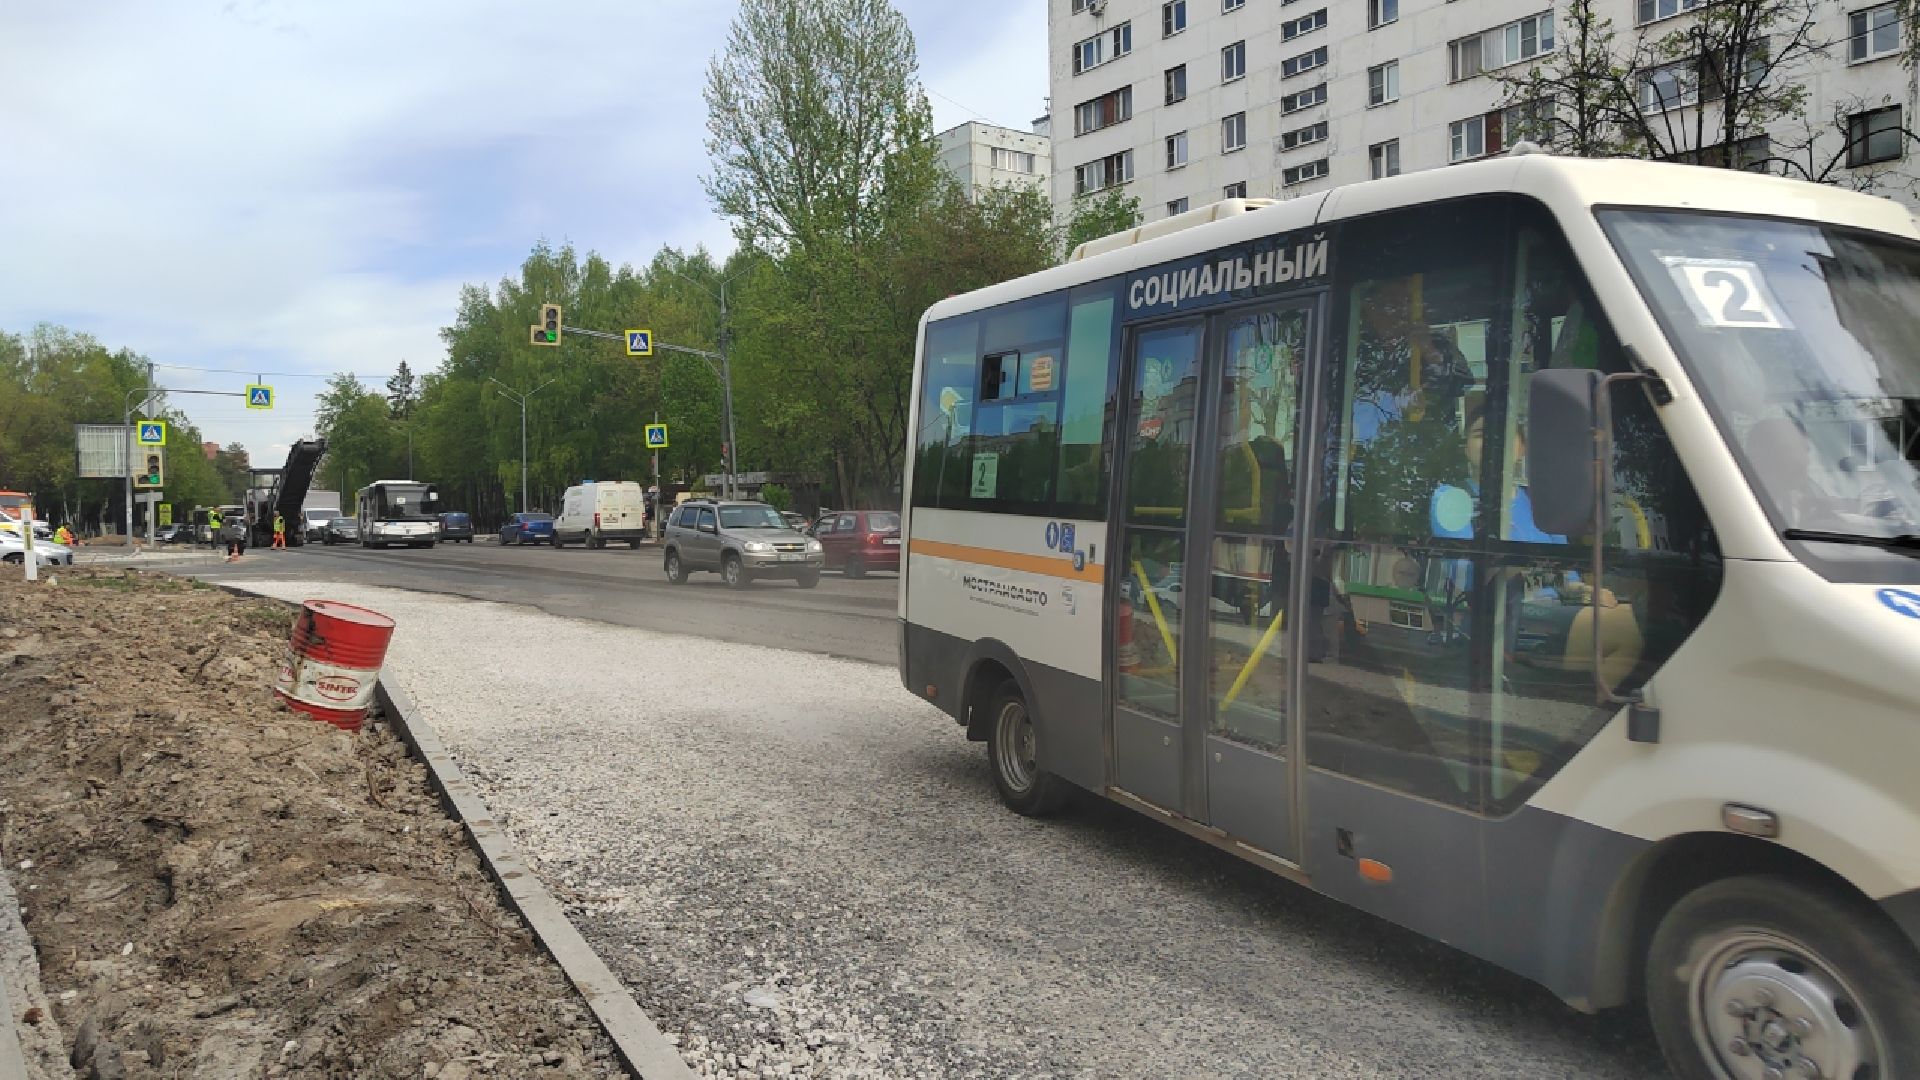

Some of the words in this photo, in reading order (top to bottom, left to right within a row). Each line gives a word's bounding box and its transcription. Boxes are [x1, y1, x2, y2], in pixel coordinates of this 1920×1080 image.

[1129, 232, 1329, 309] СОЦИАЛЬНЫЙ
[1703, 270, 1769, 323] 2
[978, 462, 986, 487] 2
[963, 576, 1047, 606] МОСТРАНСАВТО
[318, 681, 358, 693] SINTEC
